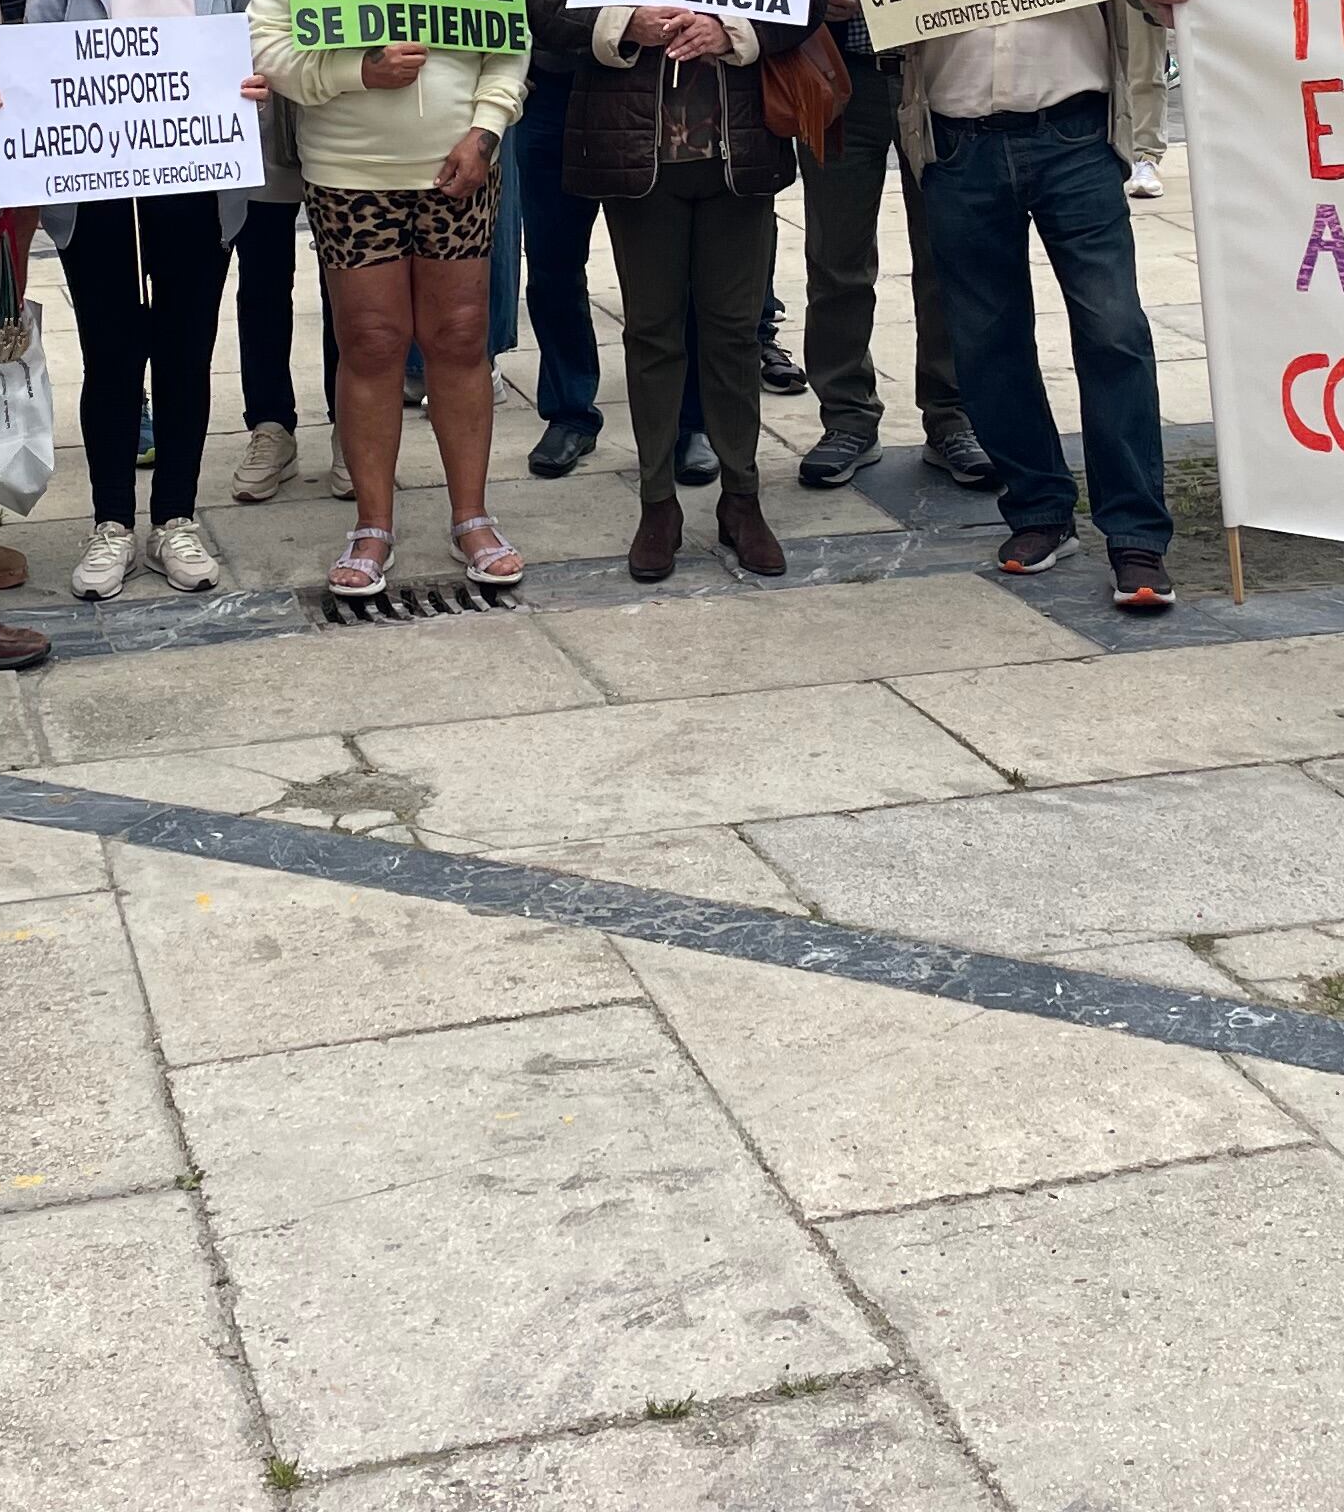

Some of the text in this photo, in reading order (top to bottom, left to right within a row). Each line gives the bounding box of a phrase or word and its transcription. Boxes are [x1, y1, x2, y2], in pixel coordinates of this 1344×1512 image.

[75, 26, 159, 61] MEJORES
[296, 3, 526, 51] SE DEFIENDE
[51, 71, 190, 109] TRANSPORTES
[4, 113, 245, 160] a LAREDO y VALDECILLA
[133, 169, 151, 187] DE
